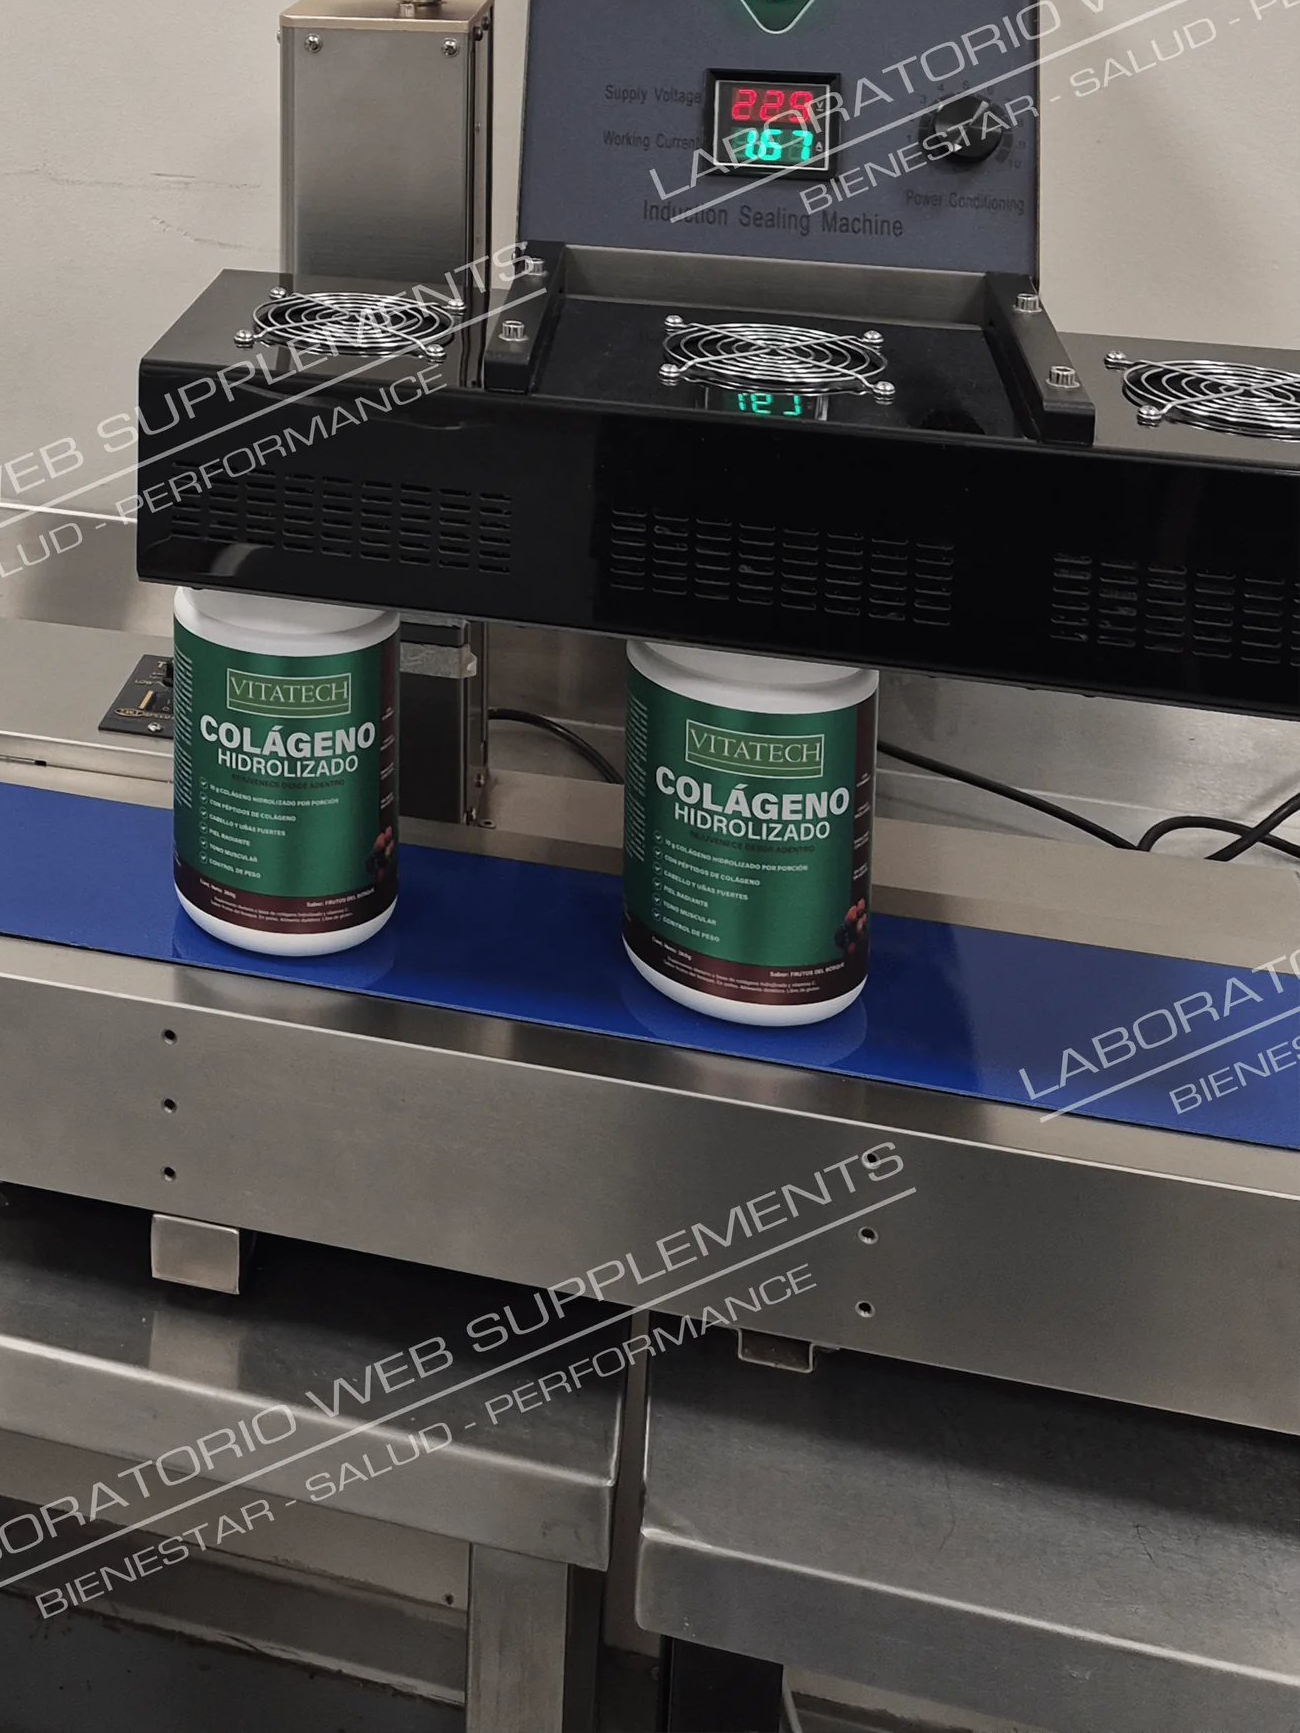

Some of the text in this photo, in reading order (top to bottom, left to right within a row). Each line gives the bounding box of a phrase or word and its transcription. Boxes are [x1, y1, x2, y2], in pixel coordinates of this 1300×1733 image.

[604, 84, 701, 106] Supply Voltage
[603, 130, 650, 151] Working
[643, 199, 904, 237] Induction Sealing Machine
[906, 189, 1025, 216] Power Conditioning
[230, 675, 349, 704] VITATECH
[200, 715, 375, 758] COLÁGENO
[690, 729, 822, 764] VITATECH
[218, 748, 359, 778] HIDROLIZADO
[655, 766, 849, 821] COLÁGENO
[674, 802, 830, 842] HIDROLIZADO
